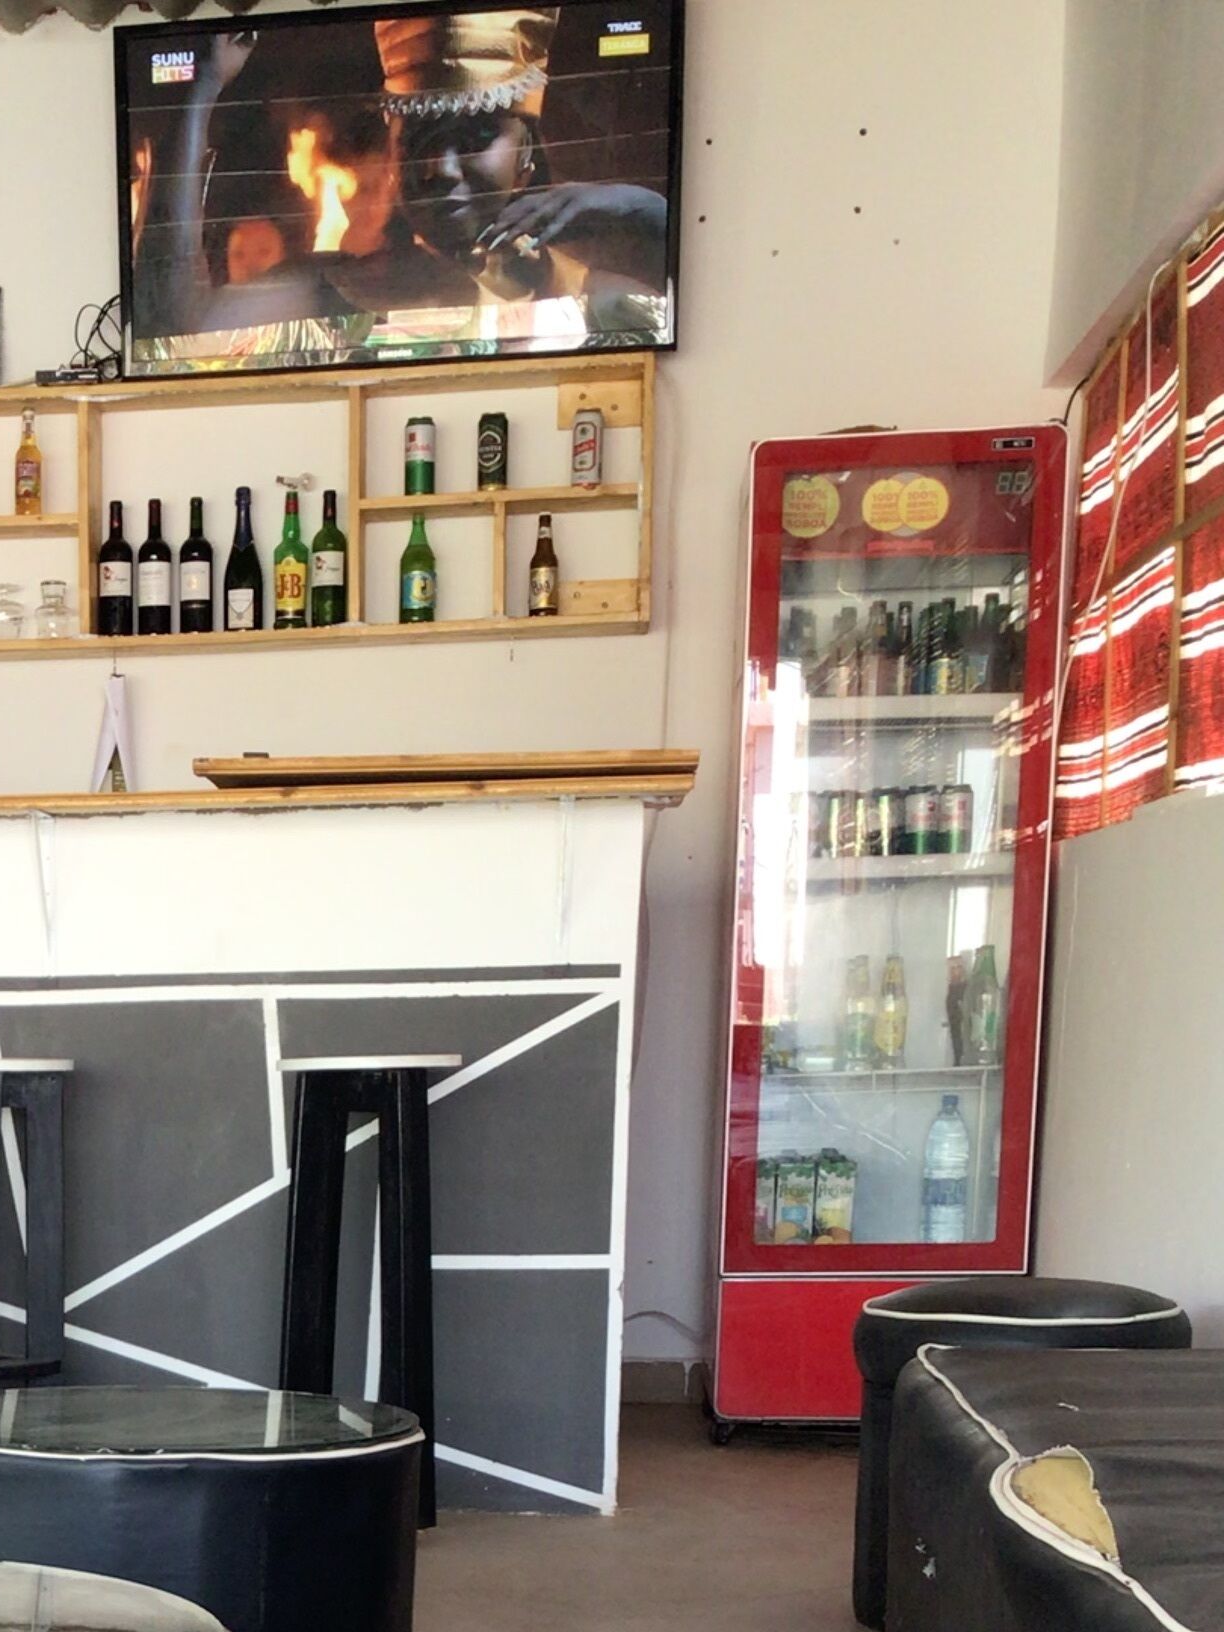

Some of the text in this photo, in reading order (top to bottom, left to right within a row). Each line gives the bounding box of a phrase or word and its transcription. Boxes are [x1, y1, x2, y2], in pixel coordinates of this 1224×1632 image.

[151, 51, 195, 66] SUNU
[152, 65, 195, 84] HITS
[790, 489, 828, 500] 100%
